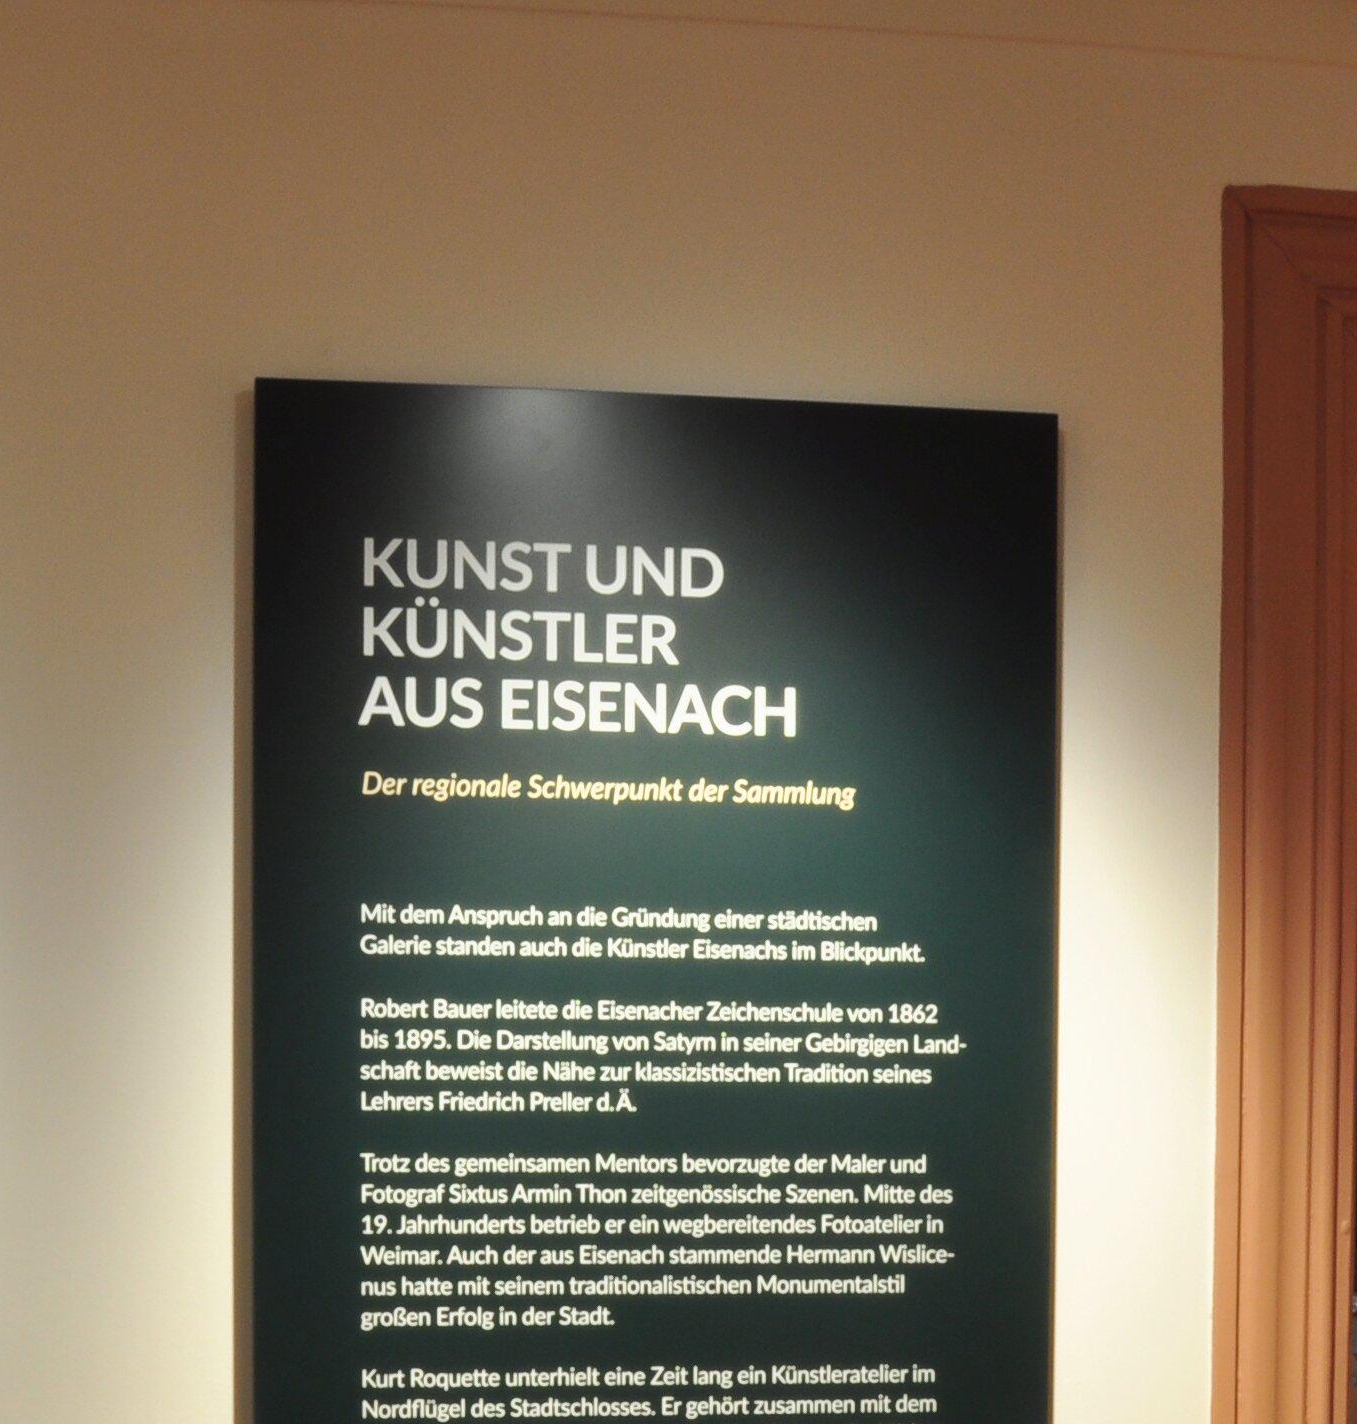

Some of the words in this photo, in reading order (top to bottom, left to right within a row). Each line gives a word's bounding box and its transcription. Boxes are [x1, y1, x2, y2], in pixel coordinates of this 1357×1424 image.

[363, 536, 572, 593] KUNST
[585, 544, 725, 599] UND
[362, 595, 680, 666] KÜNSTLER
[357, 675, 484, 730] AUS
[500, 678, 797, 738] EISENACH
[361, 770, 409, 796] Der
[411, 772, 522, 803] regionale
[526, 773, 684, 806] Schwerpunkt
[687, 776, 730, 803] der
[731, 778, 857, 812] Sammlung
[360, 902, 397, 925] Mit
[399, 902, 446, 925] dem
[447, 903, 544, 930] Anspruch
[546, 909, 573, 927] an
[575, 905, 609, 928] die
[610, 905, 712, 934] Gründung
[713, 908, 766, 930] einer
[766, 909, 878, 933] städtischen
[359, 933, 433, 956] Galerie
[435, 934, 516, 957] standen
[518, 935, 568, 958] auch
[570, 935, 604, 959] die
[606, 936, 691, 960] Künstler
[692, 938, 789, 962] Eisenachs
[791, 939, 817, 962] im
[819, 940, 926, 966] Blickpunkt.
[360, 996, 430, 1019] Robert
[432, 997, 494, 1020] Bauer
[495, 998, 559, 1021] leitete
[561, 998, 594, 1021] die
[596, 999, 705, 1022] Eisenacher
[705, 1000, 845, 1024] Zeichenschule
[845, 1006, 884, 1024] von
[887, 1002, 939, 1025] 1862
[359, 1027, 390, 1050] bis
[393, 1028, 453, 1051] 1895.
[456, 1028, 493, 1051] Die
[495, 1028, 610, 1056] Darstellung
[610, 1034, 650, 1052] von
[720, 1030, 740, 1053] in
[742, 1031, 804, 1054] seiner
[804, 1031, 910, 1058] Gebirgigen
[912, 1033, 968, 1055] Land-
[359, 1058, 422, 1081] schaft
[424, 1059, 505, 1082] beweist
[506, 1059, 539, 1082] die
[542, 1060, 597, 1082] Nähe
[598, 1065, 633, 1082] zur
[634, 1060, 782, 1083] klassizistischen
[783, 1062, 870, 1084] Tradition
[872, 1063, 933, 1085] seines
[360, 1089, 435, 1112] Lehrers
[438, 1090, 526, 1113] Friedrich
[529, 1090, 594, 1113] Preller
[358, 1151, 412, 1174] Trotz
[414, 1151, 451, 1174] des
[453, 1152, 591, 1178] gemeinsamen
[594, 1152, 679, 1174] Mentors
[681, 1152, 791, 1178] bevorzugte
[793, 1152, 829, 1175] der
[830, 1152, 888, 1175] Maler
[889, 1153, 928, 1175] und
[360, 1182, 446, 1209] Fotograf
[448, 1182, 509, 1205] Sixtus
[510, 1182, 573, 1204] Armin
[574, 1182, 628, 1205] Thon
[630, 1182, 783, 1209] zeitgenössische
[784, 1182, 860, 1205] Szenen.
[863, 1183, 917, 1205] Mitte
[918, 1183, 954, 1205] des
[361, 1213, 393, 1236] 19.
[395, 1213, 527, 1236] Jahrhunderts
[529, 1213, 602, 1235] betrieb
[603, 1218, 627, 1235] er
[628, 1213, 660, 1235] ein
[662, 1213, 817, 1239] wegbereitendes
[820, 1213, 924, 1235] Fotoatelier
[925, 1213, 945, 1234] in
[359, 1244, 444, 1266] Weimar.
[445, 1243, 499, 1266] Auch
[502, 1243, 538, 1266] der
[539, 1248, 575, 1266] aus
[578, 1243, 665, 1266] Eisenach
[668, 1243, 783, 1265] stammende
[786, 1243, 876, 1265] Hermann
[878, 1243, 956, 1265] Wislice-
[360, 1280, 398, 1297] nus
[400, 1275, 454, 1297] hatte
[457, 1274, 492, 1297] mit
[493, 1274, 566, 1297] seinem
[567, 1273, 753, 1296] traditionalistischen
[756, 1273, 906, 1295] Monumentalstil
[359, 1306, 432, 1332] großen
[436, 1305, 496, 1331] Erfolg
[498, 1305, 518, 1327] in
[520, 1305, 557, 1327] der
[558, 1304, 616, 1327] Stadt.
[361, 1368, 407, 1389] Kurt
[409, 1367, 502, 1392] Roquette
[504, 1365, 601, 1388] unterhielt
[603, 1365, 647, 1387] eine
[649, 1364, 690, 1387] Zeit
[692, 1364, 734, 1390] lang
[736, 1364, 767, 1386] ein
[771, 1363, 910, 1385] Künstleratelier
[911, 1363, 936, 1384] im
[361, 1397, 467, 1423] Nordflügel
[469, 1397, 507, 1419] des
[509, 1396, 657, 1419] Stadtschlosses.
[660, 1395, 683, 1417] Er
[684, 1394, 751, 1420] gehört
[752, 1398, 856, 1416] zusammen
[859, 1393, 892, 1414] mit
[894, 1393, 938, 1414] dem
